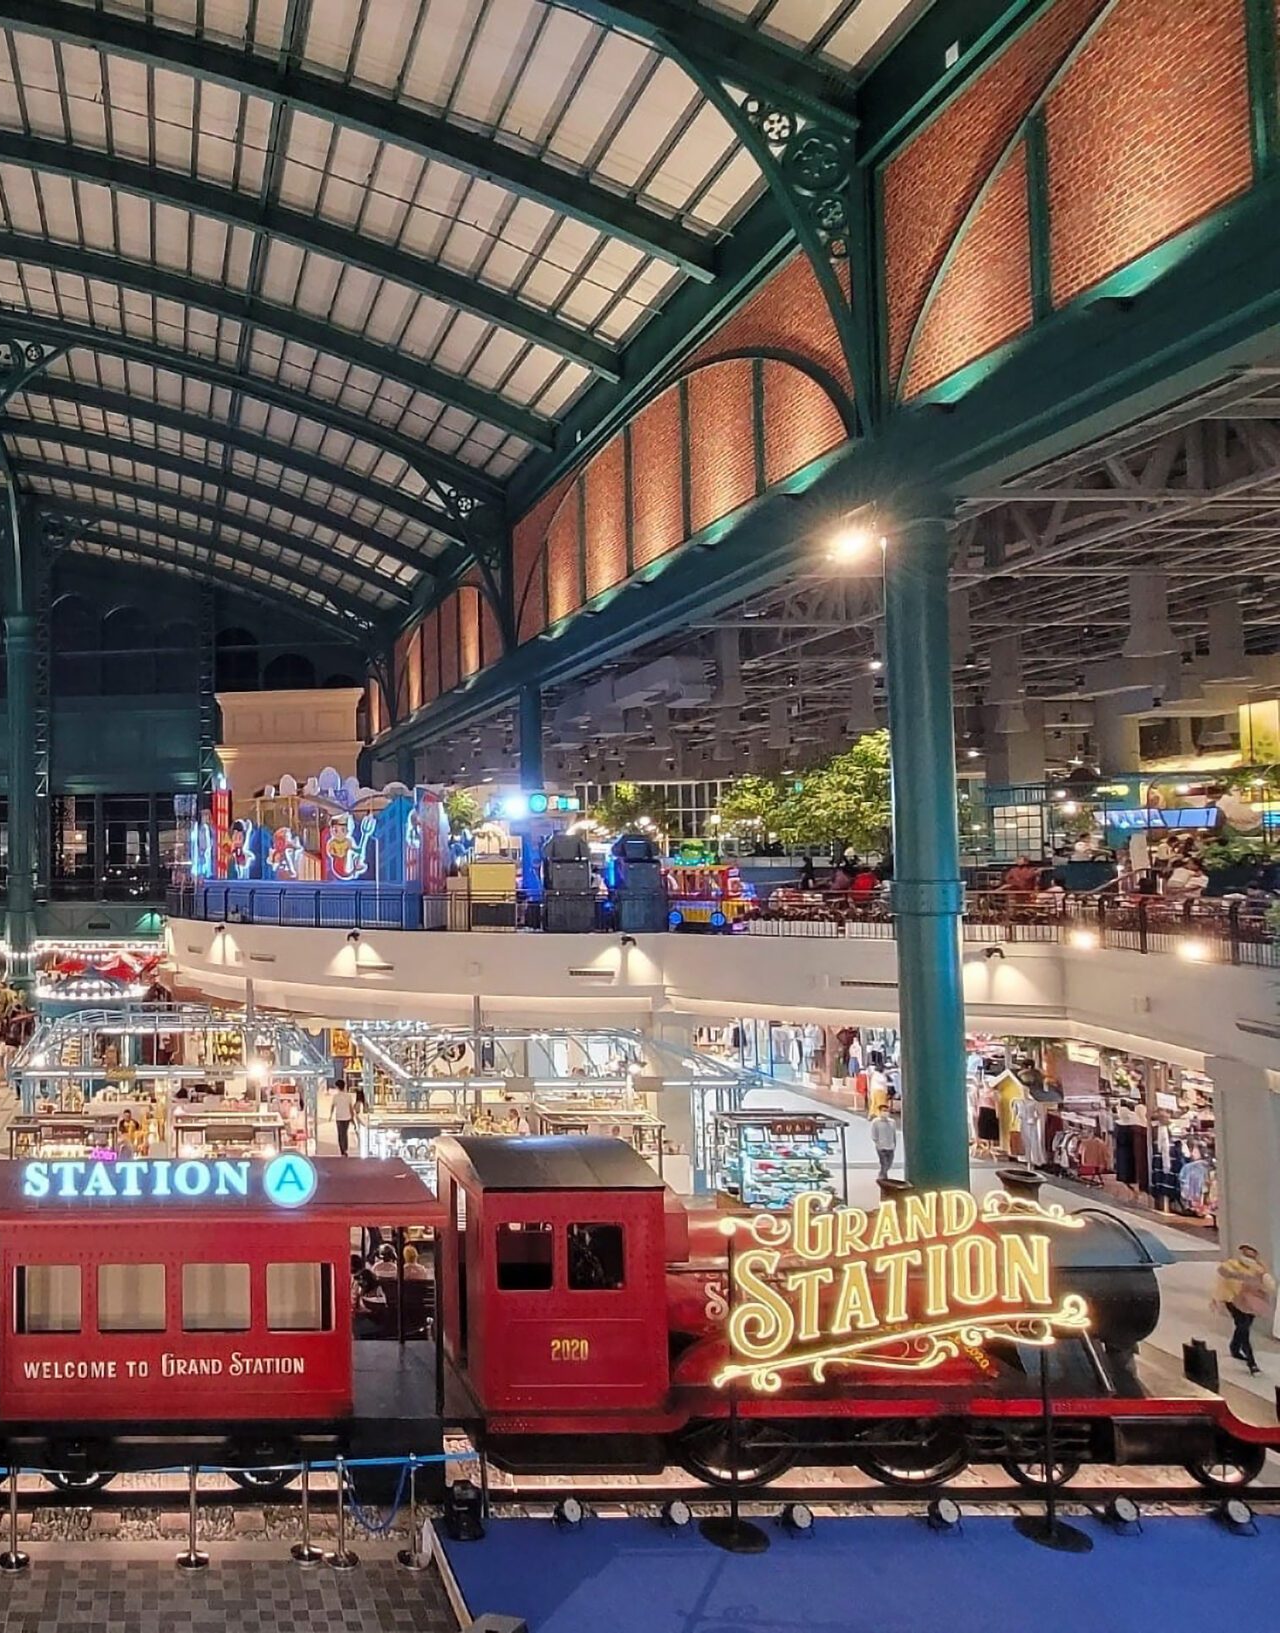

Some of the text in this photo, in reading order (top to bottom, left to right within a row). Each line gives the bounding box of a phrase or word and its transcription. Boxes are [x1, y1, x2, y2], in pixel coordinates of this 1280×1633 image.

[23, 1160, 304, 1198] STATION A
[793, 1189, 978, 1262] GRAND
[728, 1232, 1053, 1360] STATION
[23, 1351, 305, 1379] WELCOME TO GRAND STATION
[550, 1338, 589, 1361] 2020
